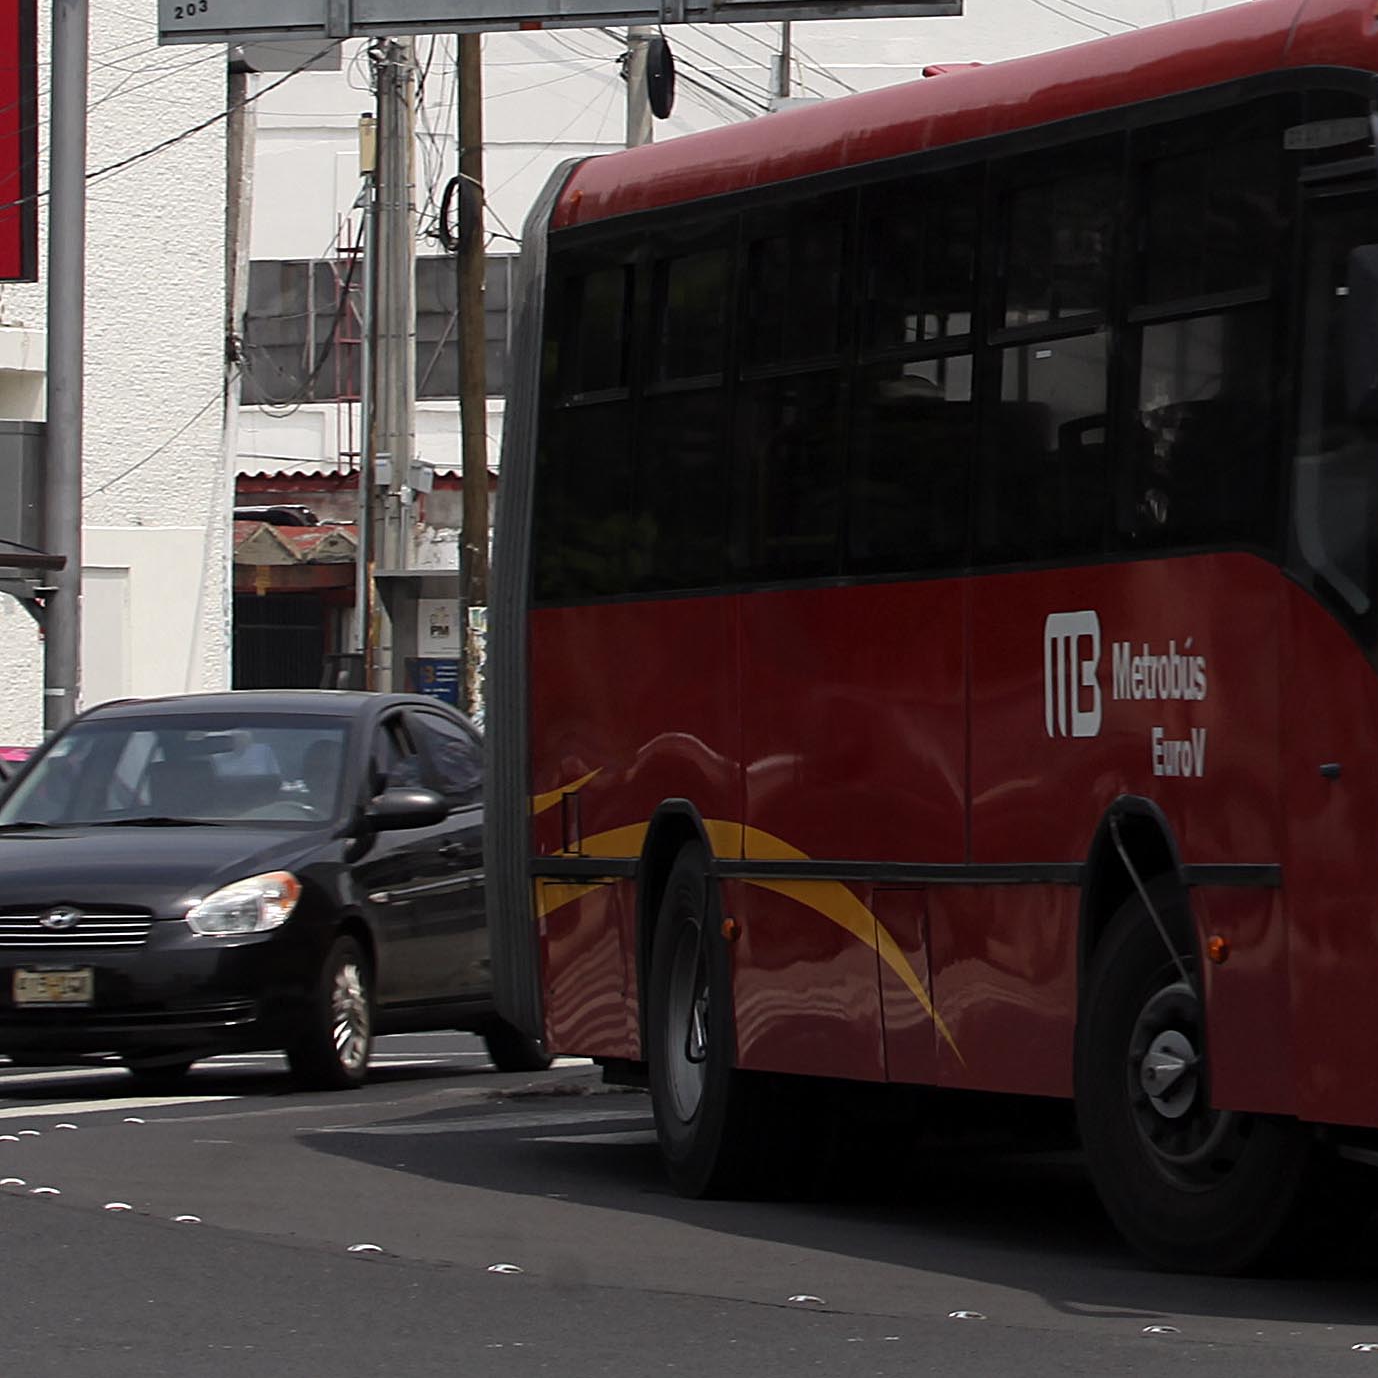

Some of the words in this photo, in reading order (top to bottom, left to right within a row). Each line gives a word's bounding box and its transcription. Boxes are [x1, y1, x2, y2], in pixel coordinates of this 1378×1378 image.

[174, 0, 209, 20] 203
[1043, 609, 1103, 739] MB
[1111, 636, 1207, 702] Metrobús
